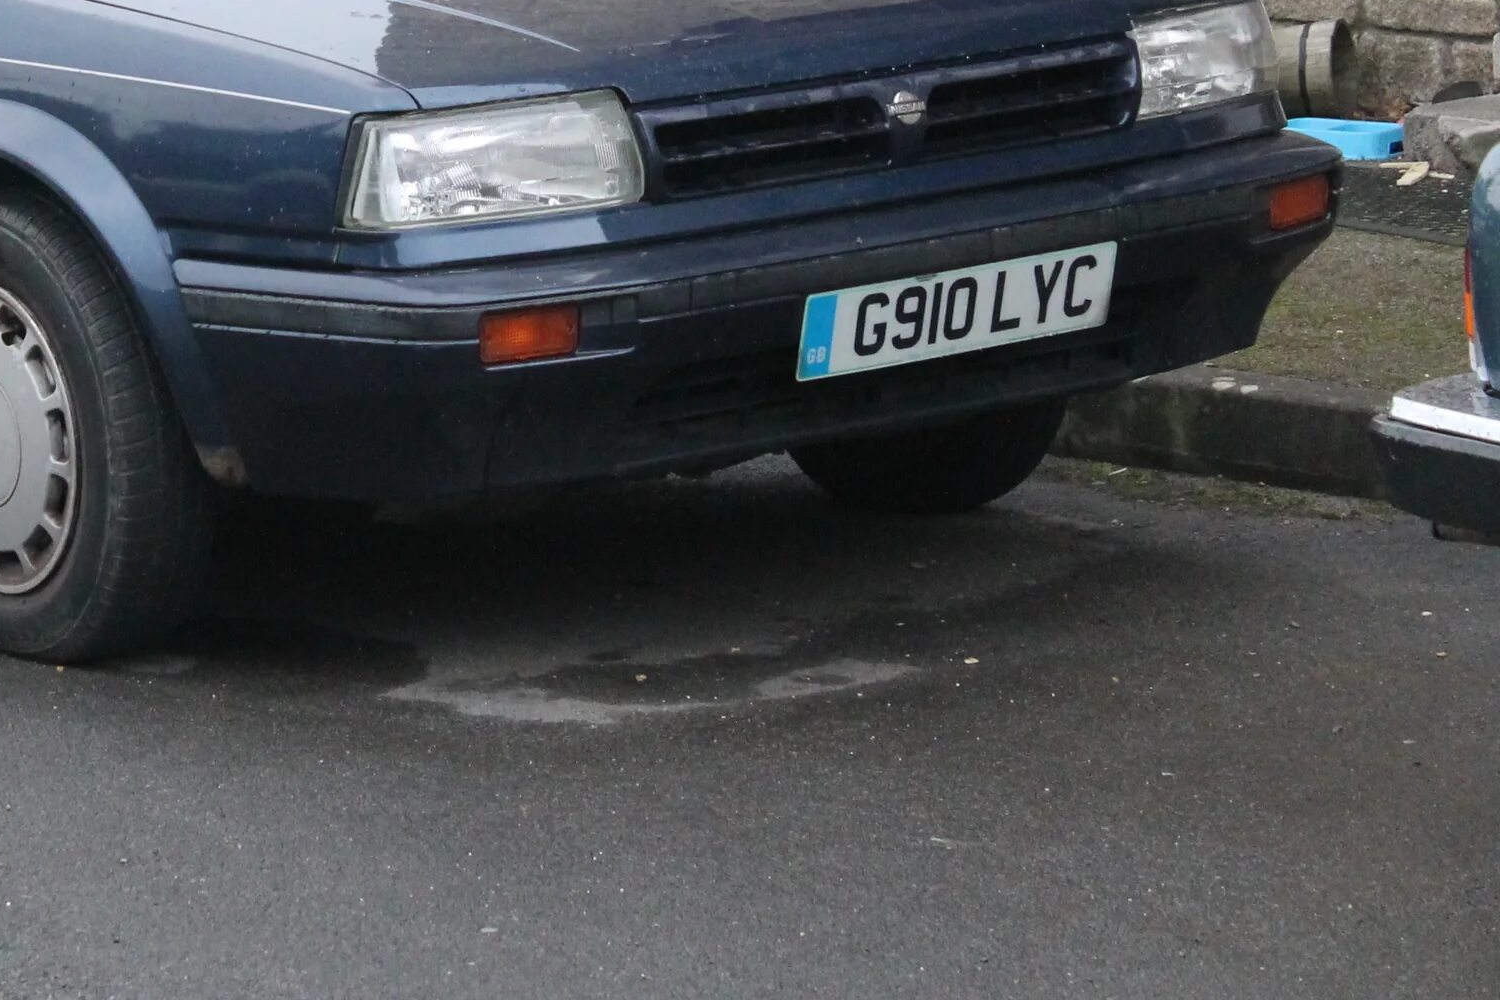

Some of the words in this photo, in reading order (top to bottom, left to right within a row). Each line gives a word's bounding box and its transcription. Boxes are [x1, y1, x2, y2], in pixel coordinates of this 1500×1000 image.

[854, 276, 978, 357] G910
[990, 254, 1098, 333] LYC
[807, 346, 826, 364] GB
